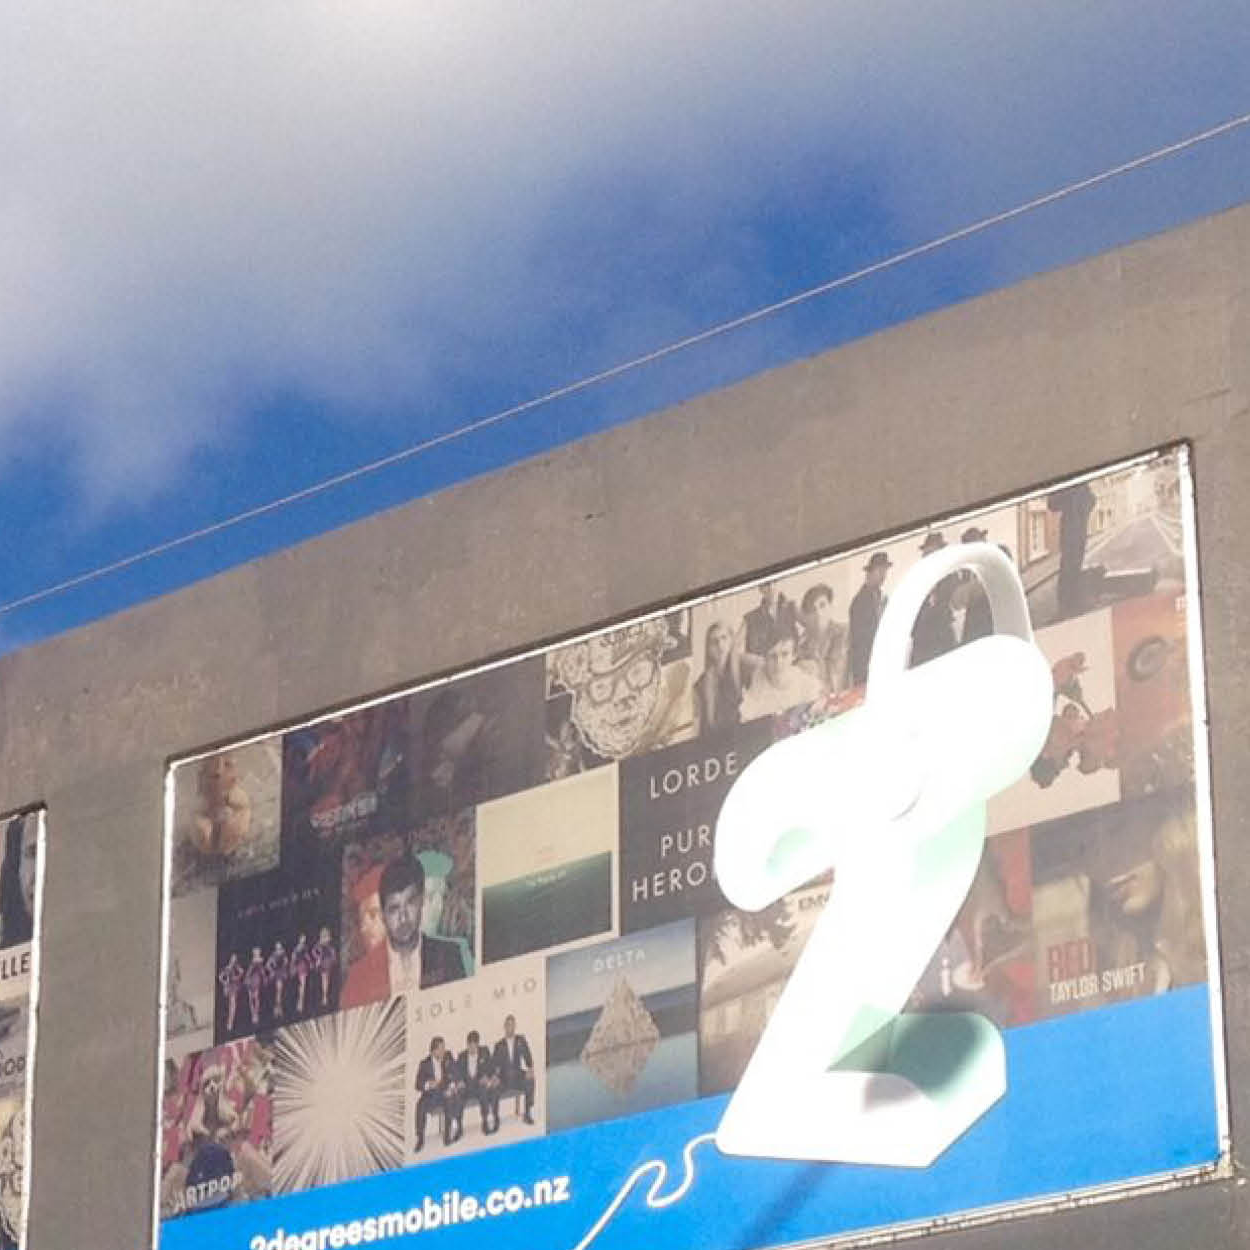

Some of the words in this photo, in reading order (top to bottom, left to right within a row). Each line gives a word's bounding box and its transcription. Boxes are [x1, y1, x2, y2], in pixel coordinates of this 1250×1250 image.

[650, 752, 739, 800] LORDE
[661, 824, 711, 858] PUR
[631, 861, 708, 903] HERO
[1050, 972, 1100, 1004] TAYLOR
[1102, 962, 1146, 993] SWIFT
